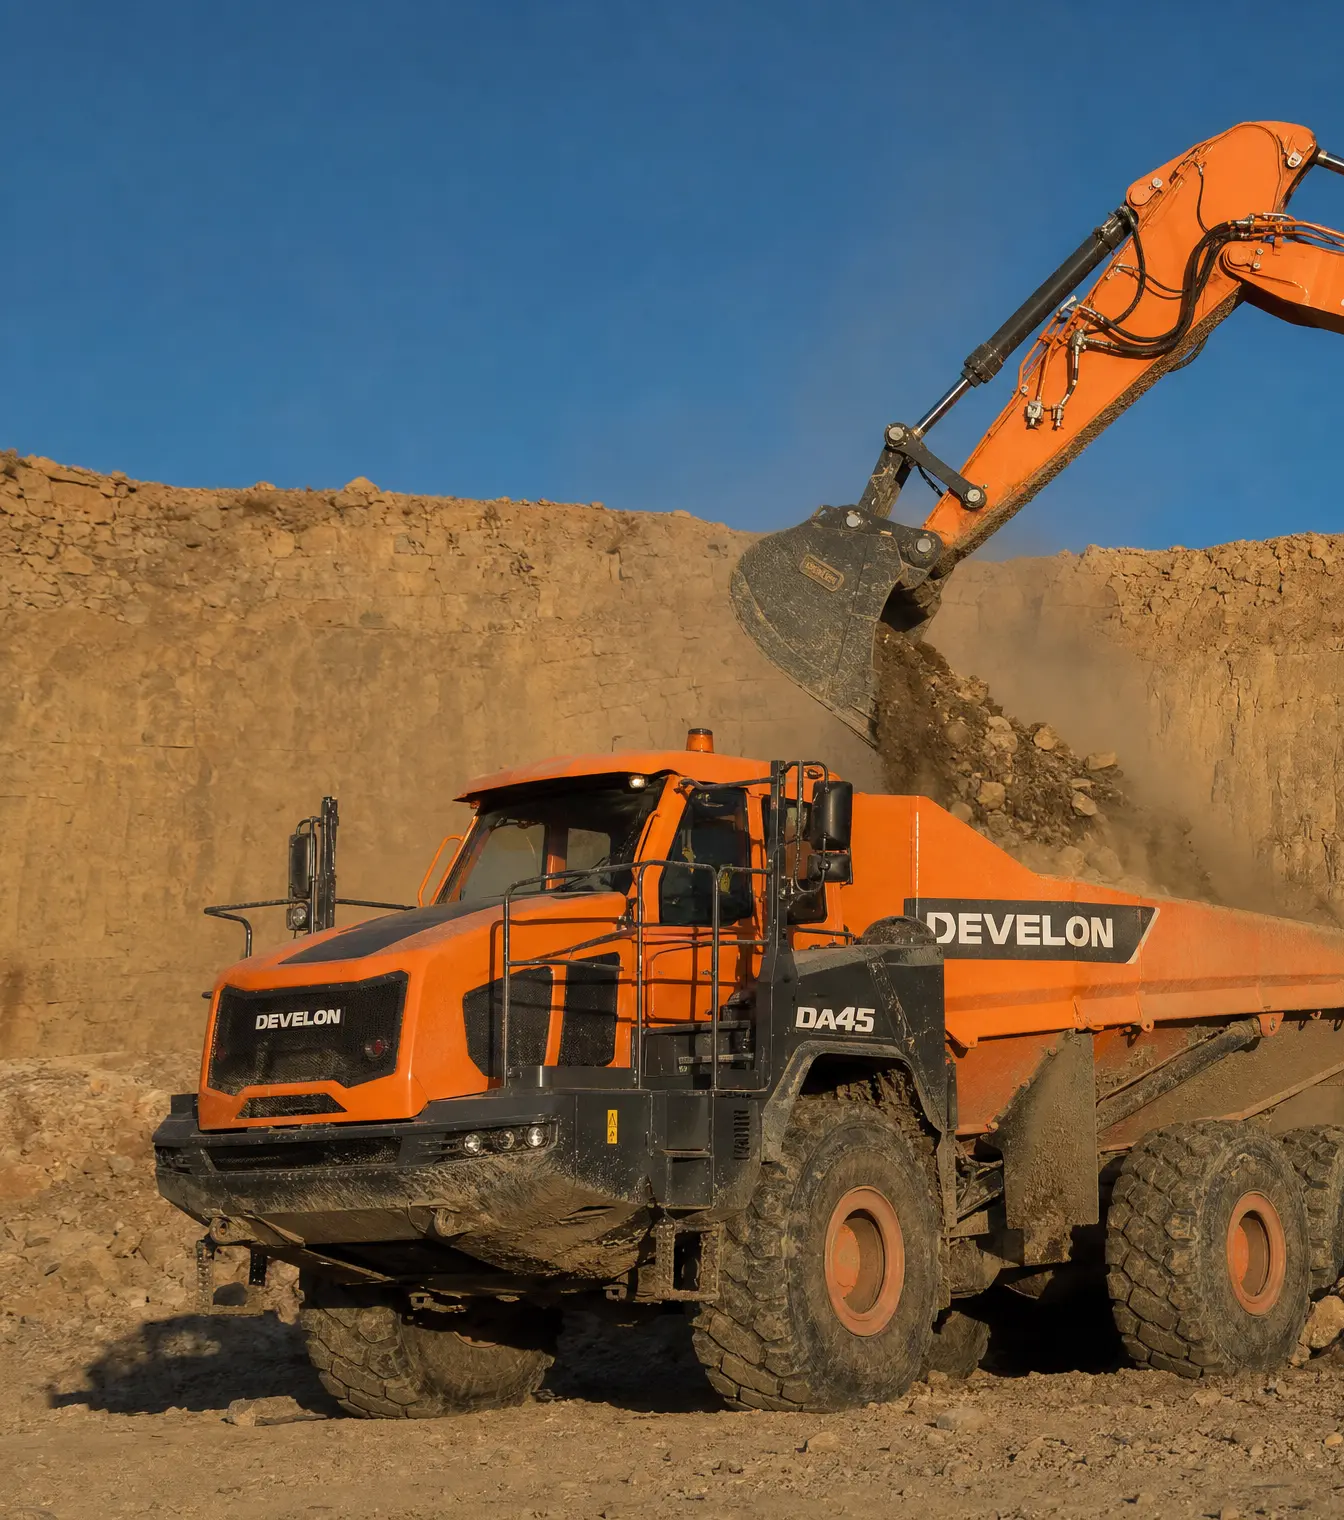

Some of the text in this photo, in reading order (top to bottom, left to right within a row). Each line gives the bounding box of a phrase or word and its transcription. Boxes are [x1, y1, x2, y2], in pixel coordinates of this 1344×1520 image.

[926, 912, 1114, 948] DEVELON
[255, 1008, 342, 1030] DEVELON
[795, 1006, 876, 1032] DA45
